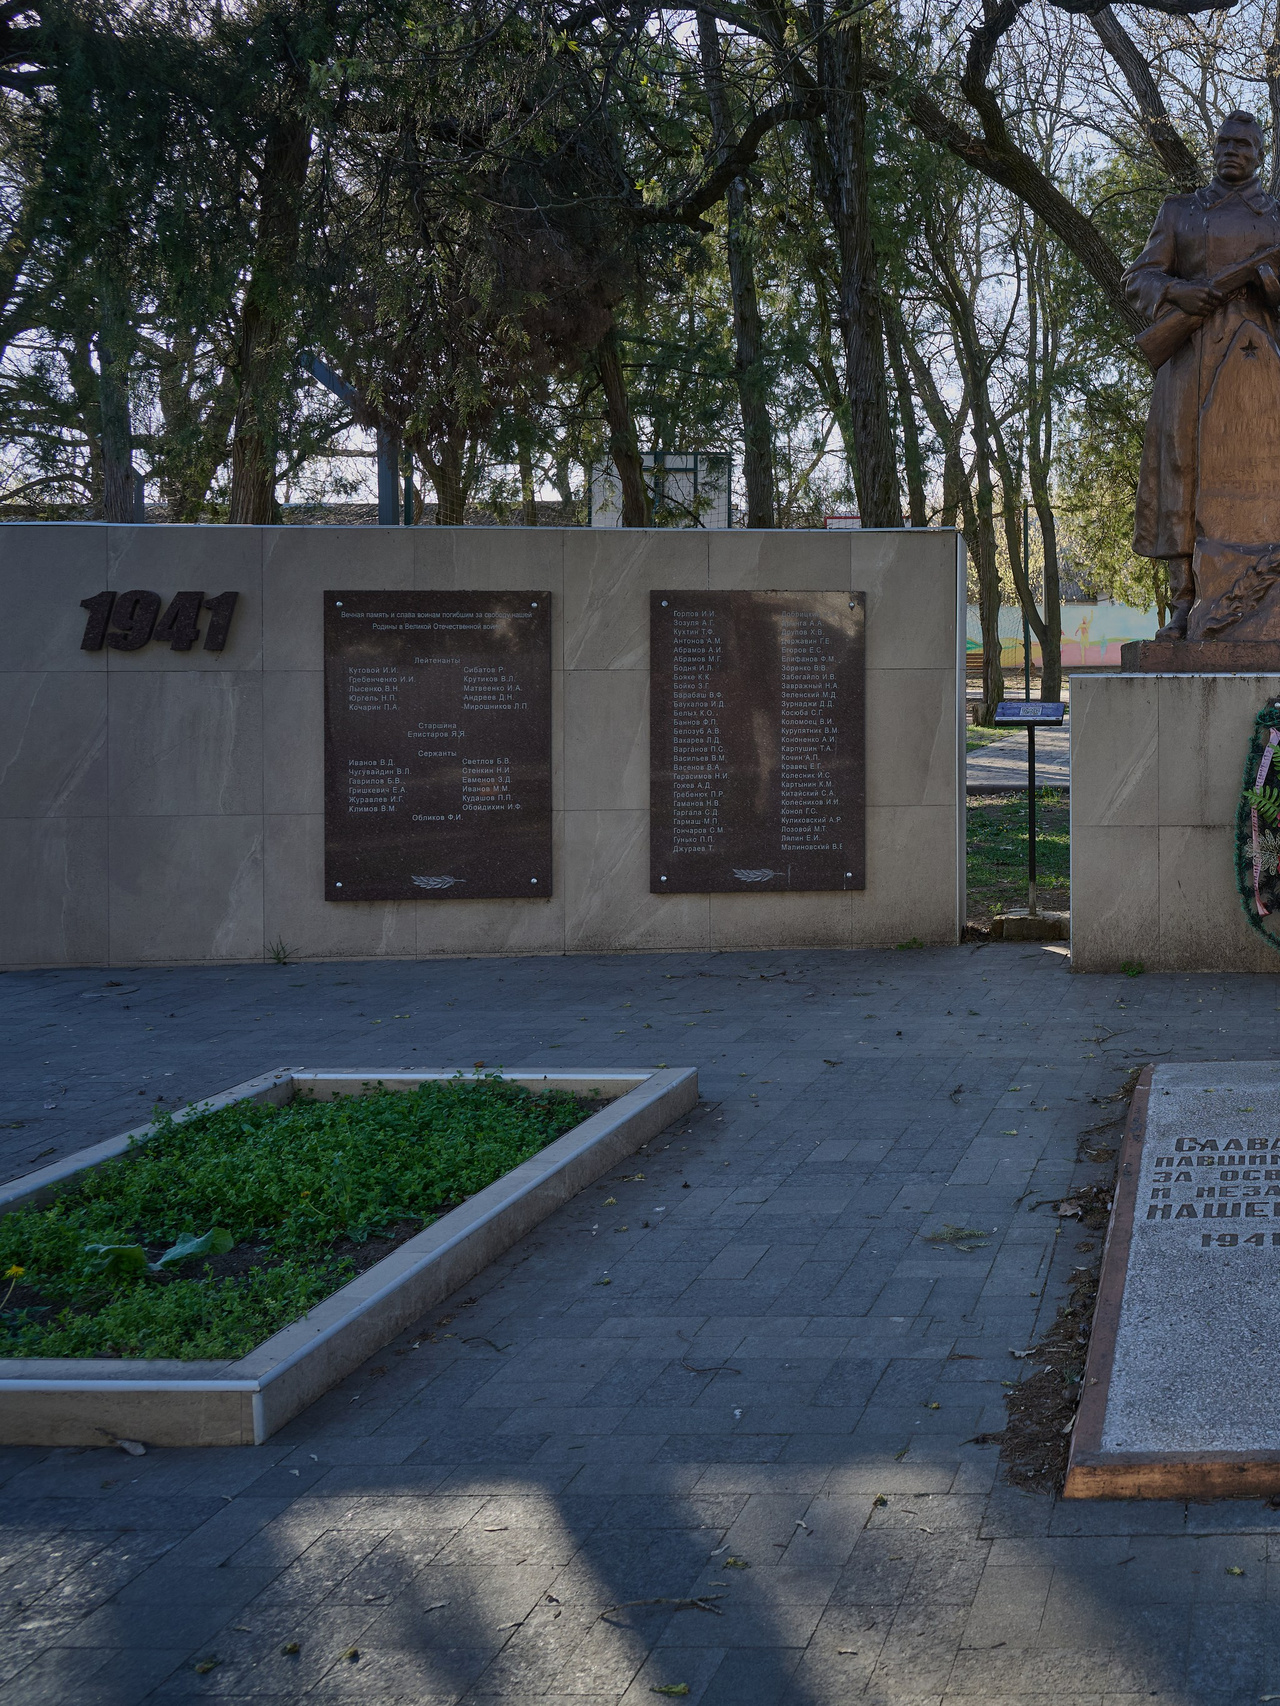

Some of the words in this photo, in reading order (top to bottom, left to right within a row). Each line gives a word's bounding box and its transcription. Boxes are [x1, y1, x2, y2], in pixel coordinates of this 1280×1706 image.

[79, 590, 240, 652] 1941
[349, 667, 380, 675] Кутовой
[674, 728, 705, 736] Белозуб
[418, 750, 457, 758] Сержанты
[349, 787, 390, 795] Гришкевич
[1153, 1171, 1193, 1183] ЗА
[1150, 1186, 1171, 1199] И
